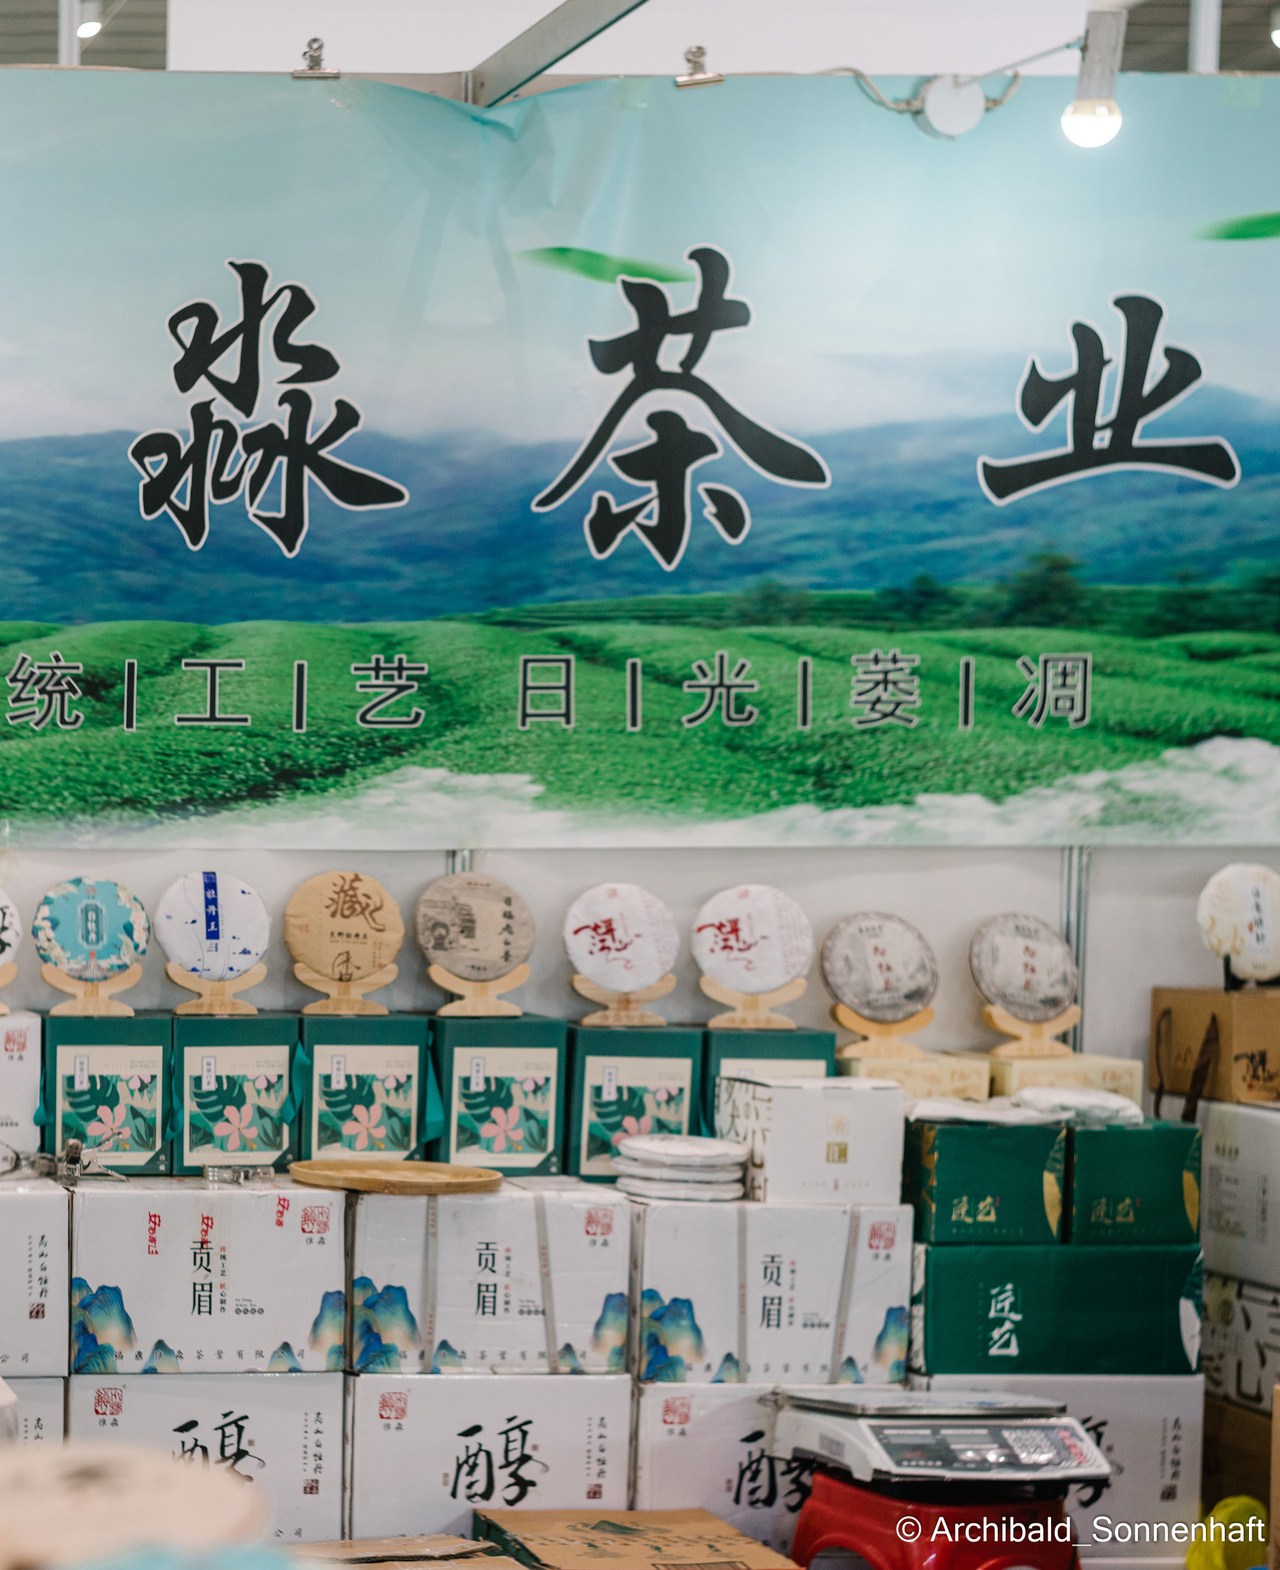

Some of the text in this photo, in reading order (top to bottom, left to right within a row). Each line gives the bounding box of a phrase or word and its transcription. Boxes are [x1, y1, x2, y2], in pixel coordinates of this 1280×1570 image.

[190, 1241, 213, 1316] 贡眉
[475, 1241, 499, 1316] 贡眉
[759, 1254, 783, 1329] 贡眉
